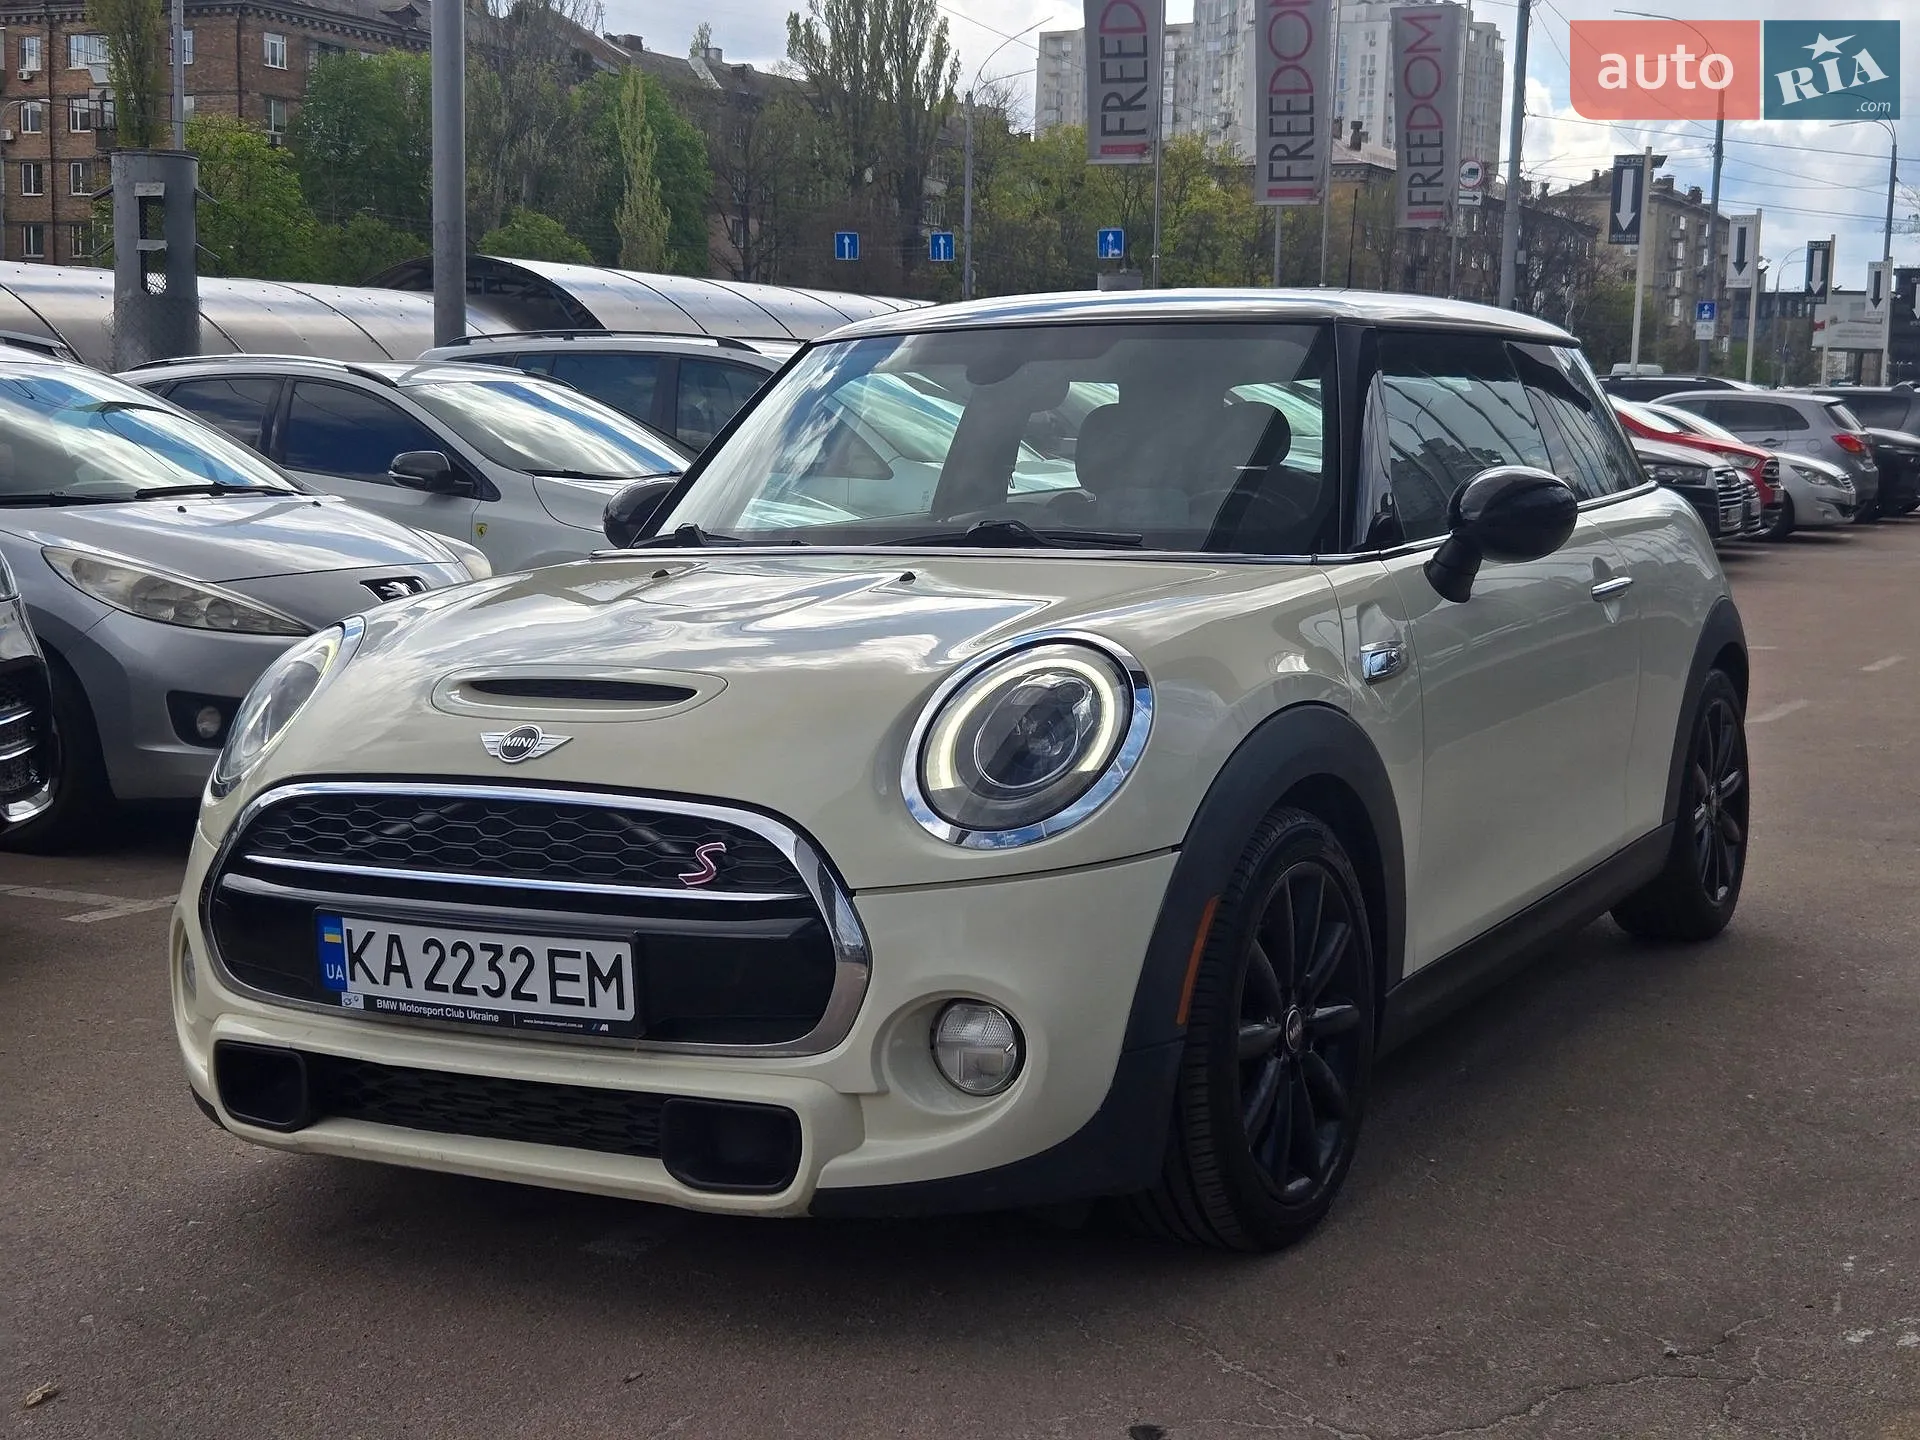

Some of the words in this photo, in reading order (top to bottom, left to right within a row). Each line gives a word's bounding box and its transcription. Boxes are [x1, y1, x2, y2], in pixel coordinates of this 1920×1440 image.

[1267, 0, 1315, 182] FREEDO
[1403, 14, 1444, 206] FREEDOM
[503, 736, 536, 748] MINI
[678, 842, 727, 885] S
[326, 963, 345, 981] UA
[345, 928, 413, 989] KA
[422, 937, 538, 1002] 2232
[547, 948, 625, 1011] EM
[376, 999, 398, 1011] BMW
[399, 1001, 444, 1017] Motorsport
[445, 1007, 465, 1019] Club
[466, 1010, 499, 1023] Ukraine
